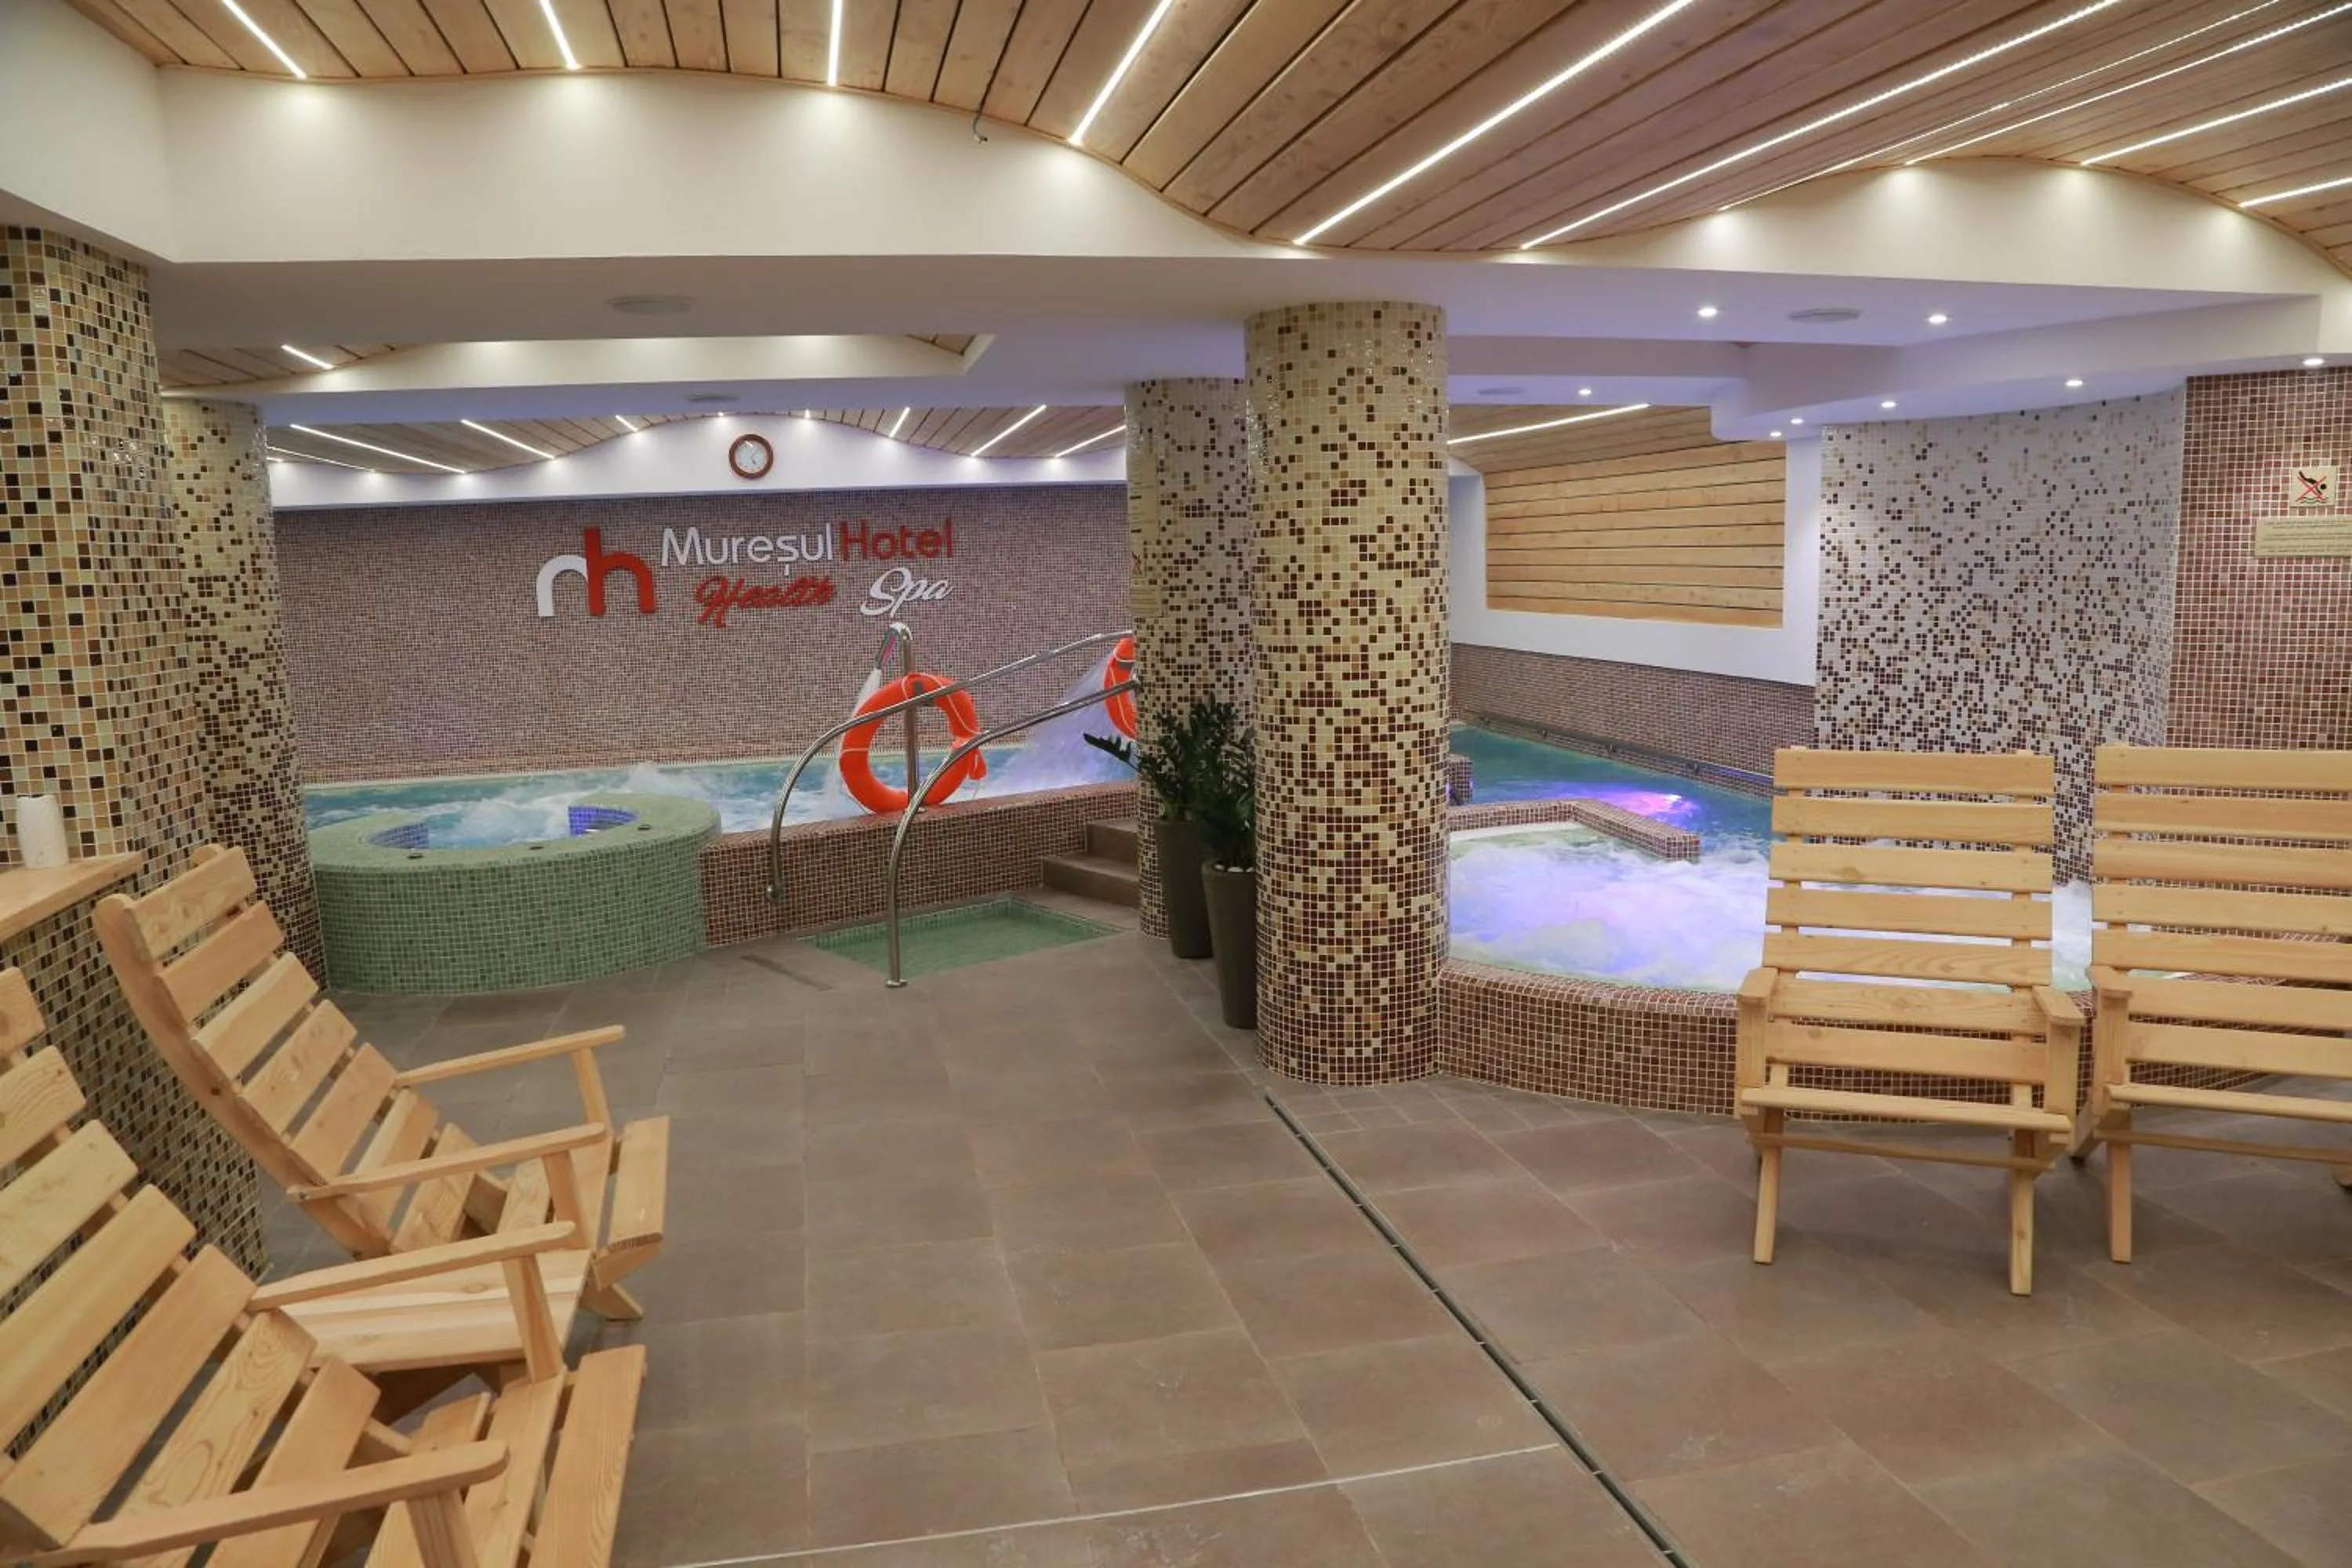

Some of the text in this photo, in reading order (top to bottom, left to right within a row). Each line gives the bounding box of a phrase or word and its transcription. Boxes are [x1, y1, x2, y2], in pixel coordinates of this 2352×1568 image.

[837, 519, 953, 561] Hotel
[695, 566, 953, 627] Health Spa
